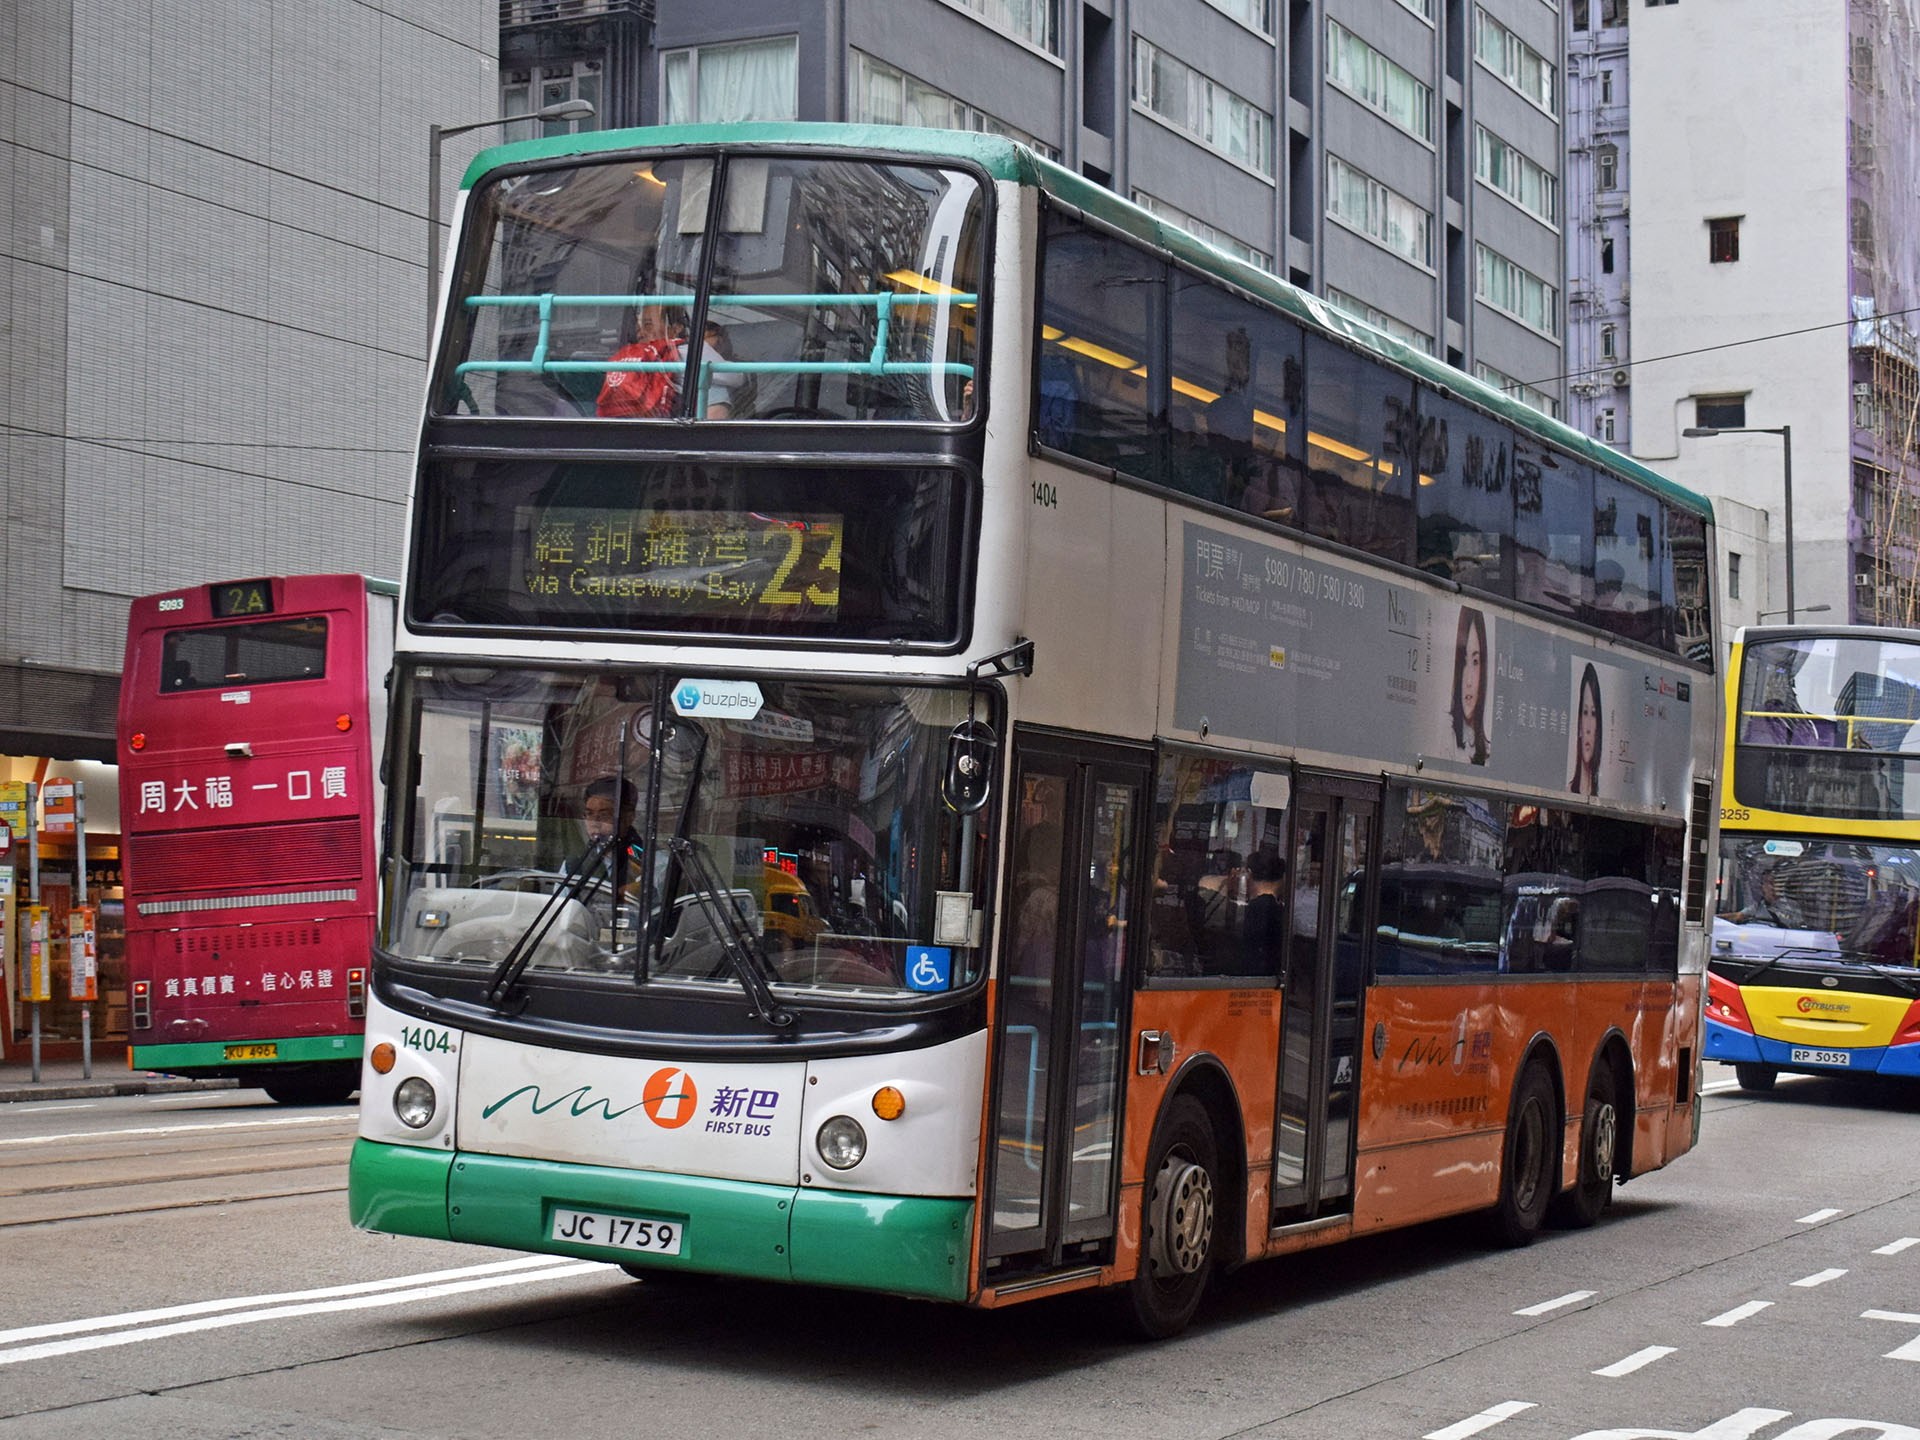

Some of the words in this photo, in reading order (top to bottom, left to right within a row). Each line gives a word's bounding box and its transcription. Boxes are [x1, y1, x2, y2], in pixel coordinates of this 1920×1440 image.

[1032, 481, 1057, 509] 1404
[1196, 539, 1224, 580] 門票
[527, 566, 559, 594] via
[569, 568, 697, 604] Causeway
[707, 570, 756, 606] Bay
[1265, 556, 1289, 589] $980
[1297, 567, 1315, 595] 780
[1323, 575, 1341, 602] 580
[1348, 581, 1365, 609] 380
[159, 597, 184, 612] 5093
[228, 588, 265, 614] 2A
[1407, 647, 1418, 672] 12
[702, 691, 758, 709] buzplay
[140, 776, 233, 815] 周大福
[252, 766, 348, 801] 一口價
[1720, 808, 1750, 821] 8255
[165, 974, 236, 998] 貨真價實
[261, 969, 334, 993] 信心保證
[228, 1045, 245, 1059] KU
[250, 1043, 278, 1058] 4964
[401, 1026, 450, 1054] 1404
[1794, 1050, 1811, 1061] RP
[1816, 1052, 1848, 1064] 5052
[710, 1086, 779, 1119] 新巴
[705, 1120, 743, 1135] FIRST
[744, 1123, 771, 1137] BUS
[561, 1214, 596, 1240] JC
[608, 1218, 674, 1249] 1759
